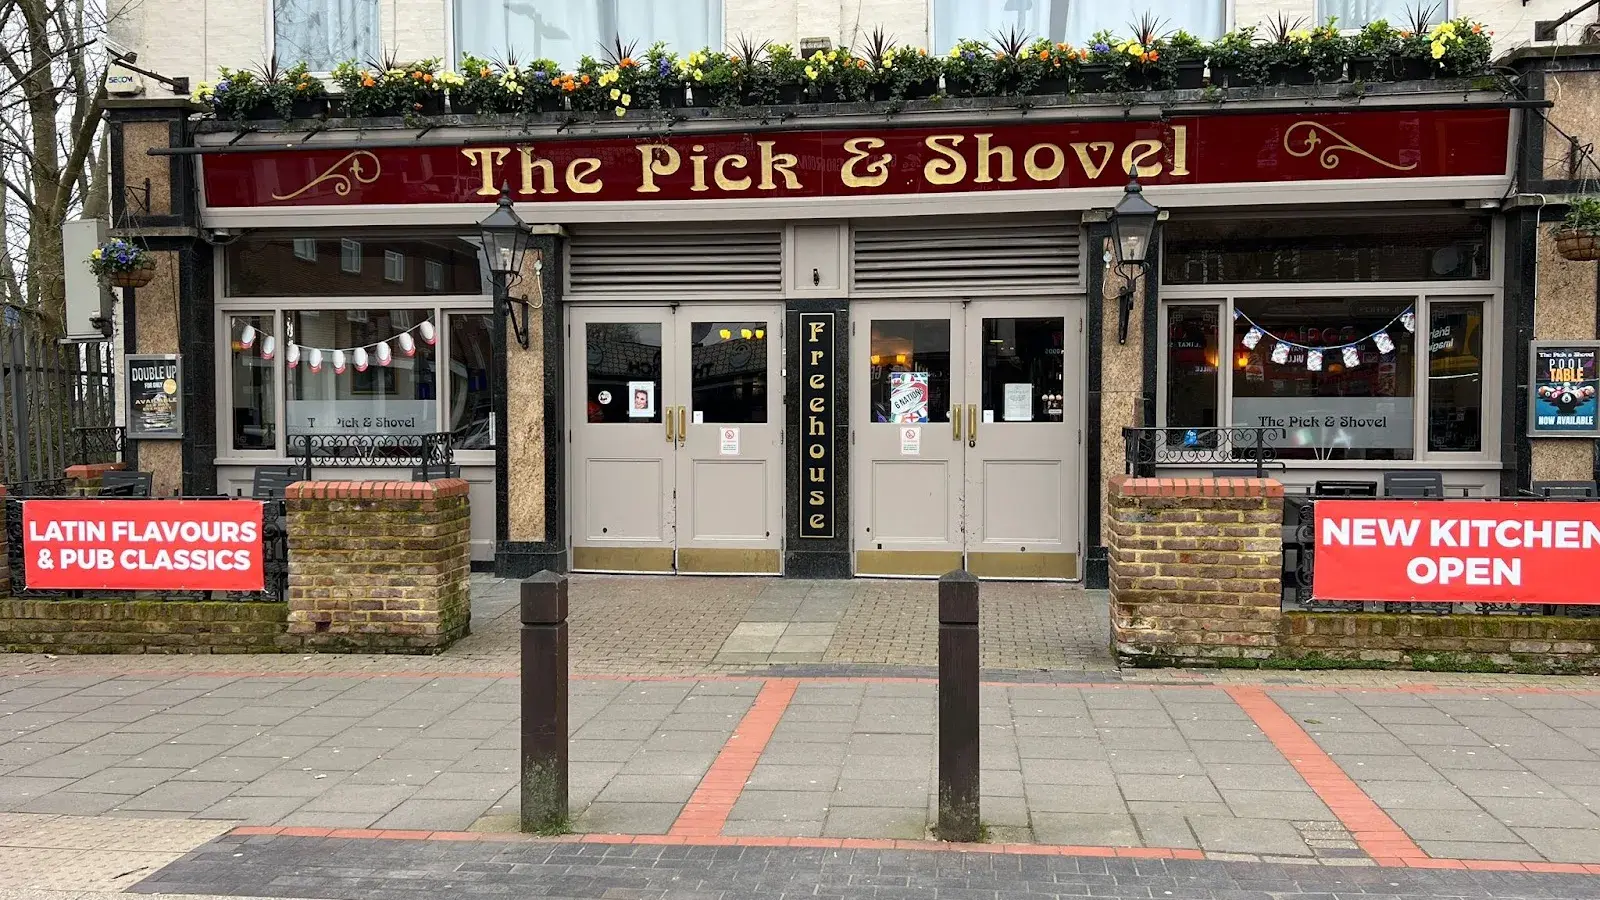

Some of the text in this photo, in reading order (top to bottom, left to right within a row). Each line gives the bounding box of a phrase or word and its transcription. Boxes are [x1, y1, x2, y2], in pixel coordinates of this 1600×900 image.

[461, 124, 1191, 196] The Pick & Shovel
[131, 364, 177, 381] DOUBLE UP
[1549, 358, 1583, 370] POOL
[1550, 368, 1584, 382] TABLE
[363, 418, 372, 428] &
[375, 417, 415, 428] Shovel
[808, 321, 826, 530] Freehouse
[1258, 415, 1388, 428] The Pick & Shovel
[1538, 416, 1594, 425] NOW AVAILABLE
[29, 520, 257, 543] LATIN FLAVOURS
[1322, 518, 1600, 549] NEW KITCHEN
[37, 548, 251, 571] & PUB CLASSICS
[1406, 556, 1522, 586] OPEN
